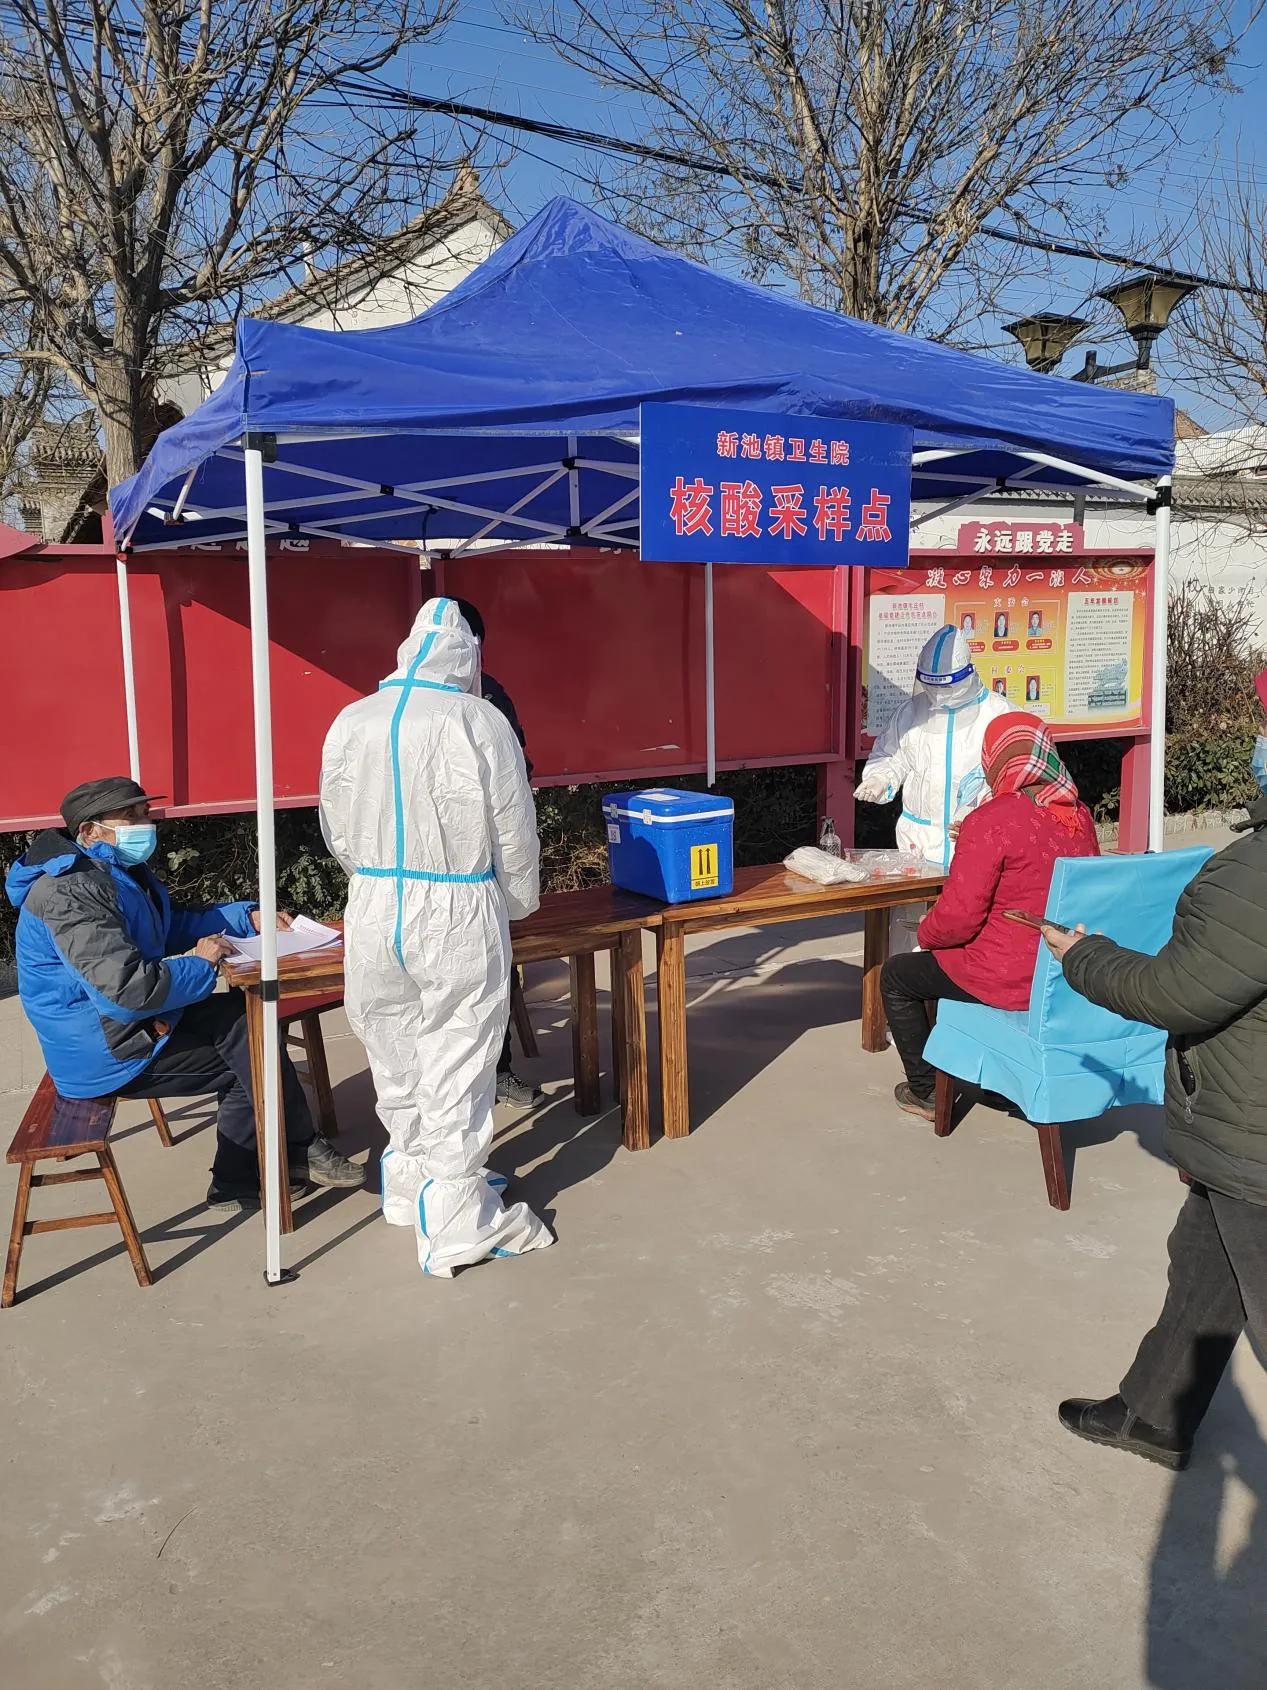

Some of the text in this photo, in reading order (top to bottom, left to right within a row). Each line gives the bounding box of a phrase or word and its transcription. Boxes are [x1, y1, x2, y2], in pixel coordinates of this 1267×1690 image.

[716, 430, 850, 466] 新池镇卫生院
[669, 476, 892, 543] 核酸采样点
[974, 528, 1074, 553] 永远跟党走
[925, 563, 1092, 589] 凝心聚力一班人
